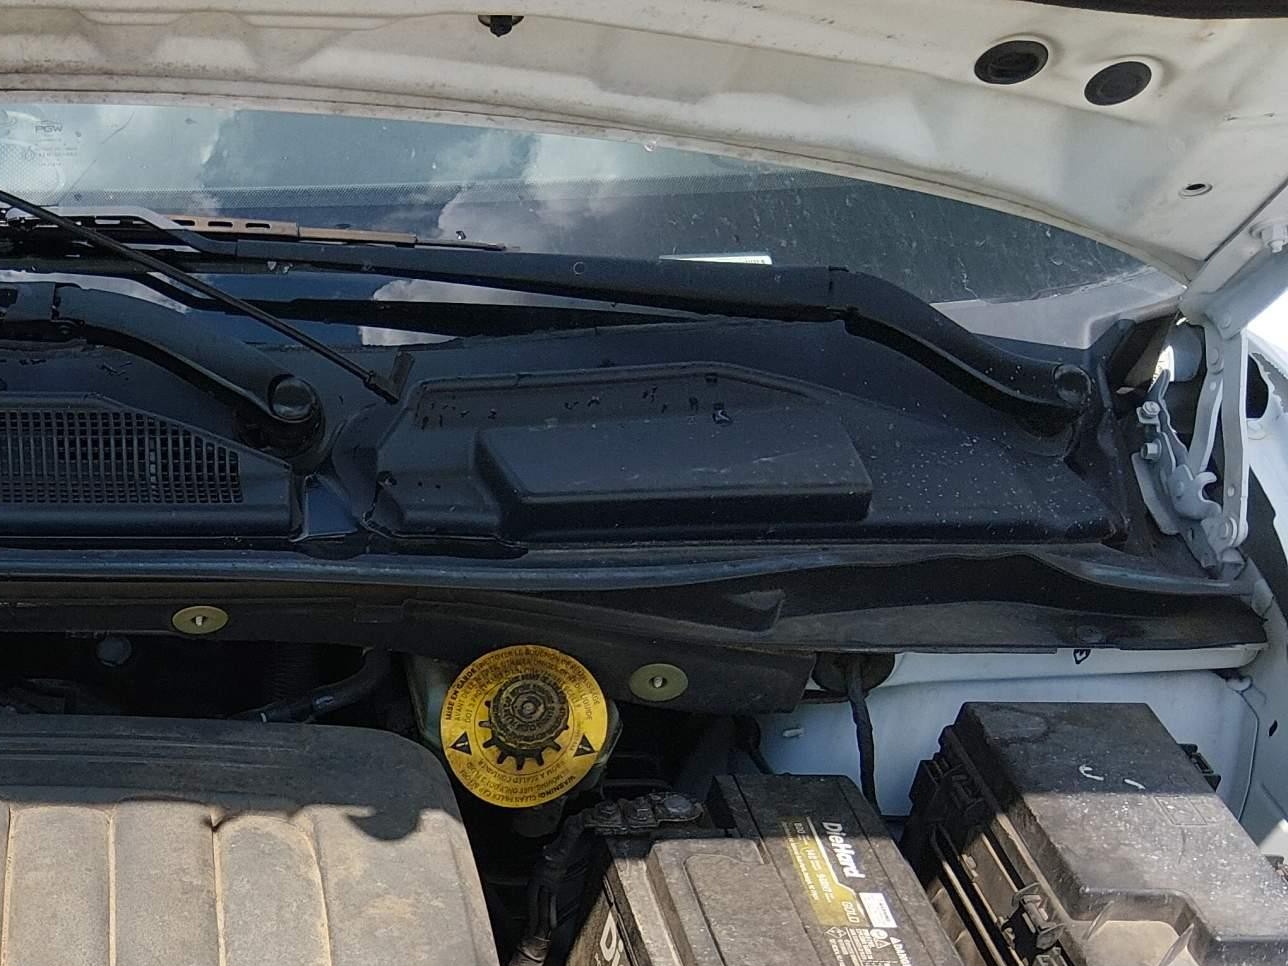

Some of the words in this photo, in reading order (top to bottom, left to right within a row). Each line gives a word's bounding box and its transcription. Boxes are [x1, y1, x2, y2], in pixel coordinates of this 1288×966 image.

[454, 666, 478, 691] GARDE
[449, 687, 461, 701] EN
[444, 699, 455, 720] MISE
[821, 821, 866, 879] DieHard
[841, 900, 860, 924] GOLD
